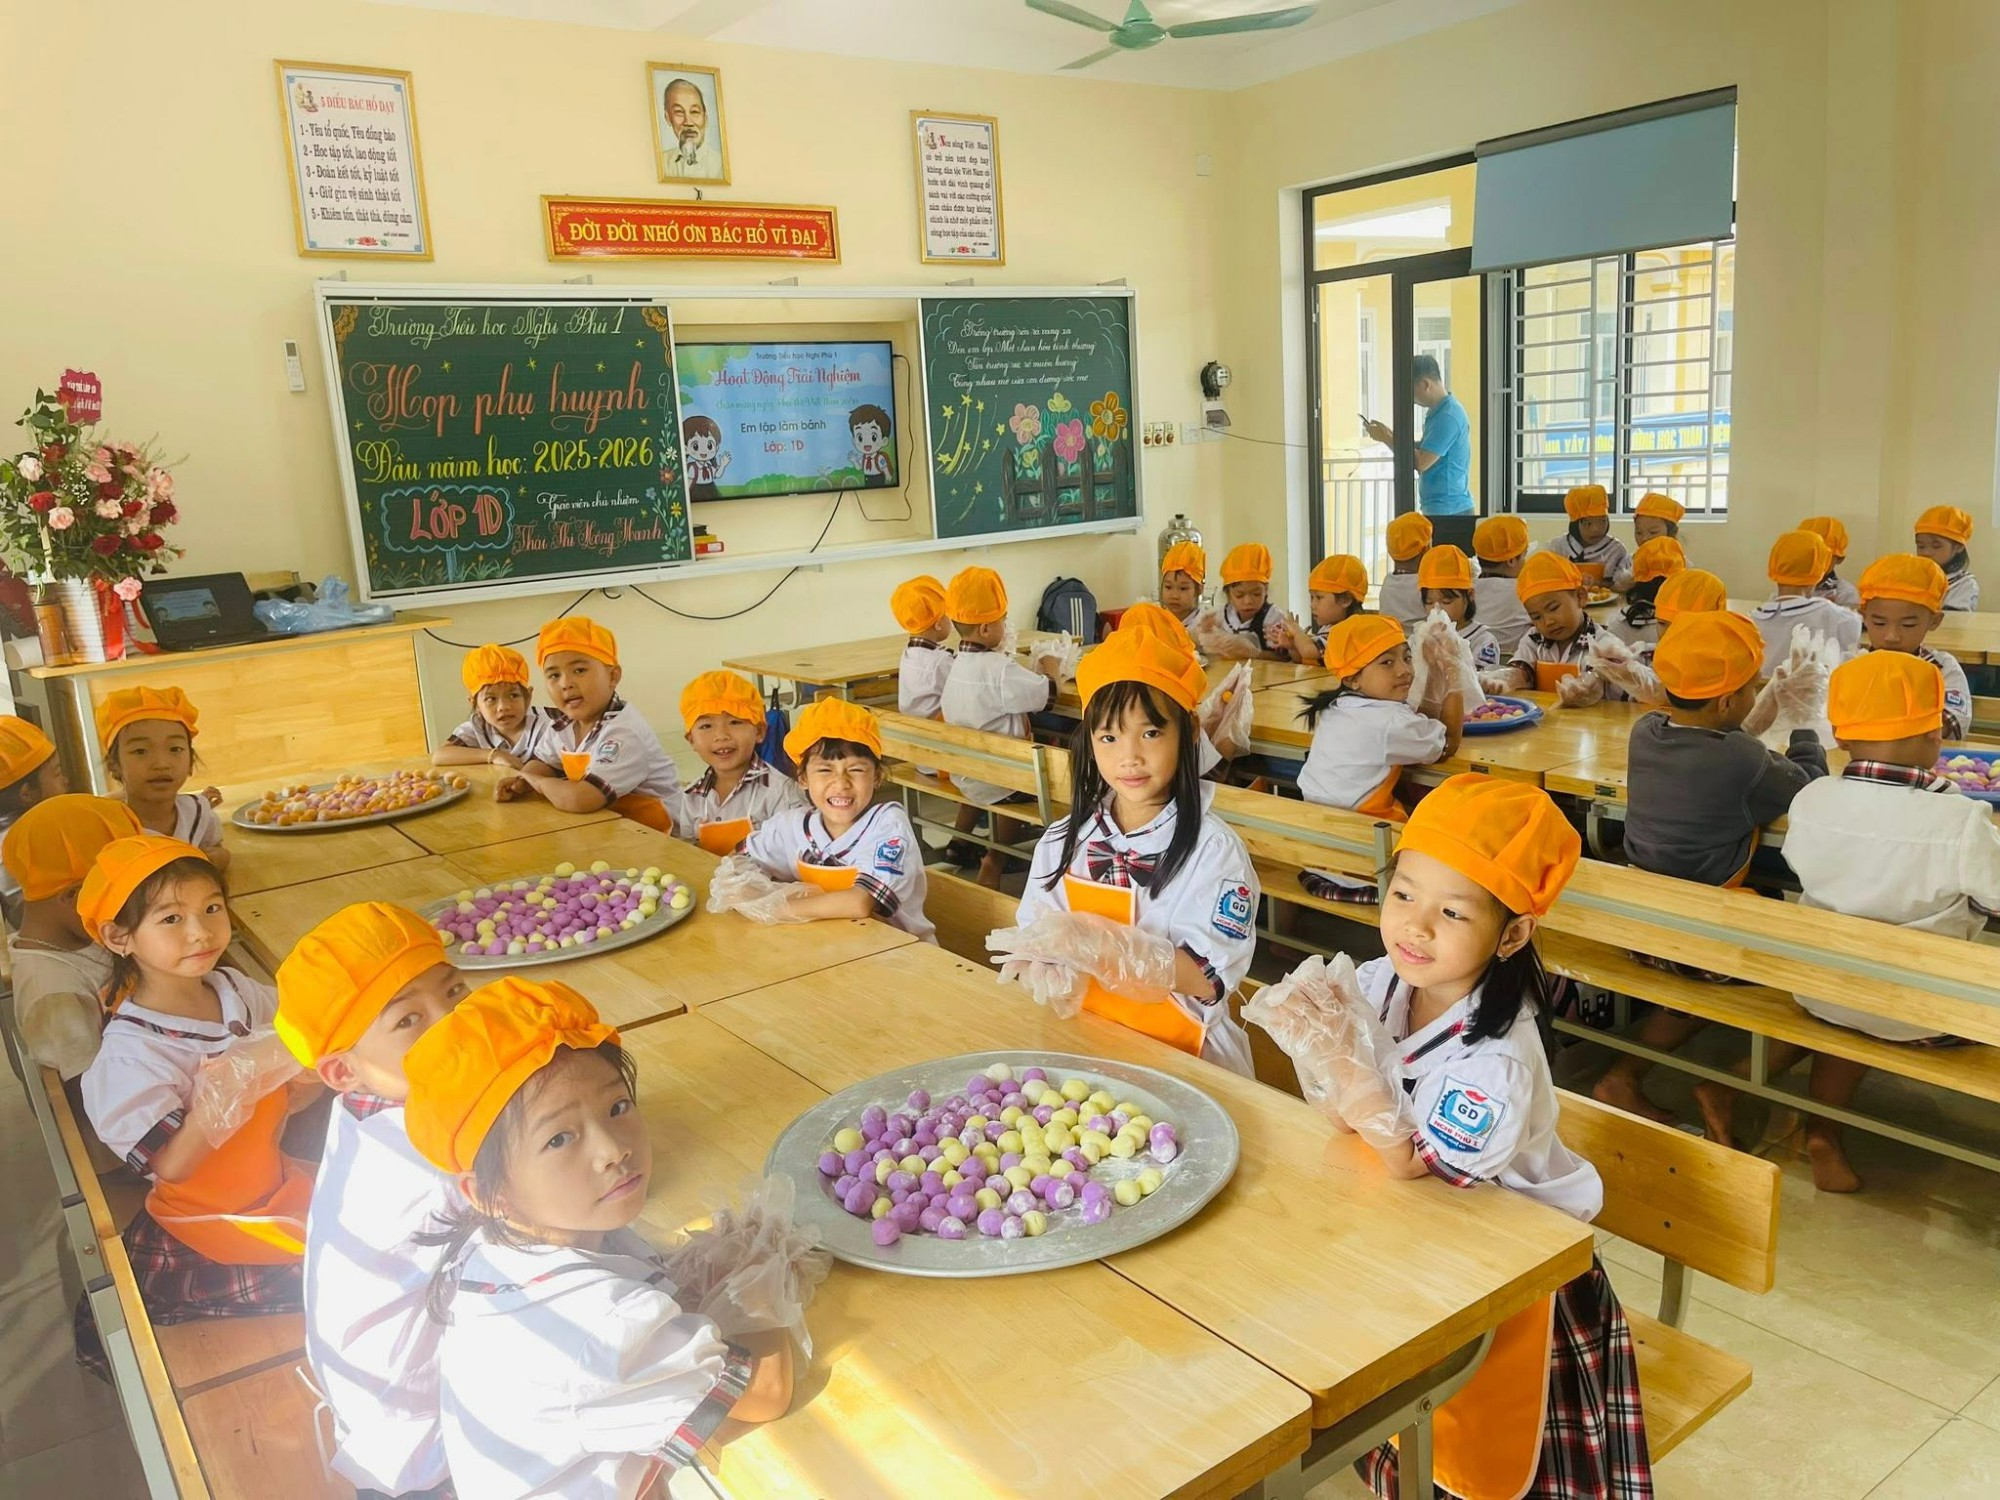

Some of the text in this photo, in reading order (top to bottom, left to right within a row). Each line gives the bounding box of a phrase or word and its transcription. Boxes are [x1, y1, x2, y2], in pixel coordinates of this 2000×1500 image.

[309, 123, 323, 136] Yêu
[324, 120, 332, 137] tổ
[351, 126, 364, 140] Yêu
[314, 144, 328, 160] Học
[329, 145, 341, 162] tập
[368, 148, 386, 164] động
[387, 148, 397, 162] tốt
[317, 165, 336, 179] Đoàn
[337, 164, 349, 180] kết
[389, 167, 399, 182] tốt
[320, 186, 333, 198] Giữ
[391, 188, 401, 202] tốt
[569, 217, 818, 249] ĐỜI ĐỜI NHỚ ƠN BÁC HỒ VĨ ĐẠI
[368, 306, 437, 350] Trường
[440, 306, 477, 337] Tiểu
[512, 306, 558, 349] Nghi
[564, 307, 608, 334] Phú
[611, 306, 624, 334] 1
[756, 352, 776, 360] Trường
[792, 352, 804, 360] học
[806, 352, 819, 360] Nghi
[714, 364, 861, 392] Hoạt Động Trải Nghiệm
[975, 373, 996, 386] nhau
[350, 360, 650, 438] Họp phụ huynh
[741, 420, 826, 435] Em tập làm bánh
[764, 440, 804, 453] Lớp: 1D
[356, 434, 653, 483] Đầu năm học: 2025-2026
[571, 498, 590, 508] viên
[610, 488, 639, 506] nhiệm
[410, 490, 502, 540] LỚP 1D
[1232, 901, 1246, 912] GD
[1458, 1104, 1478, 1120] GD
